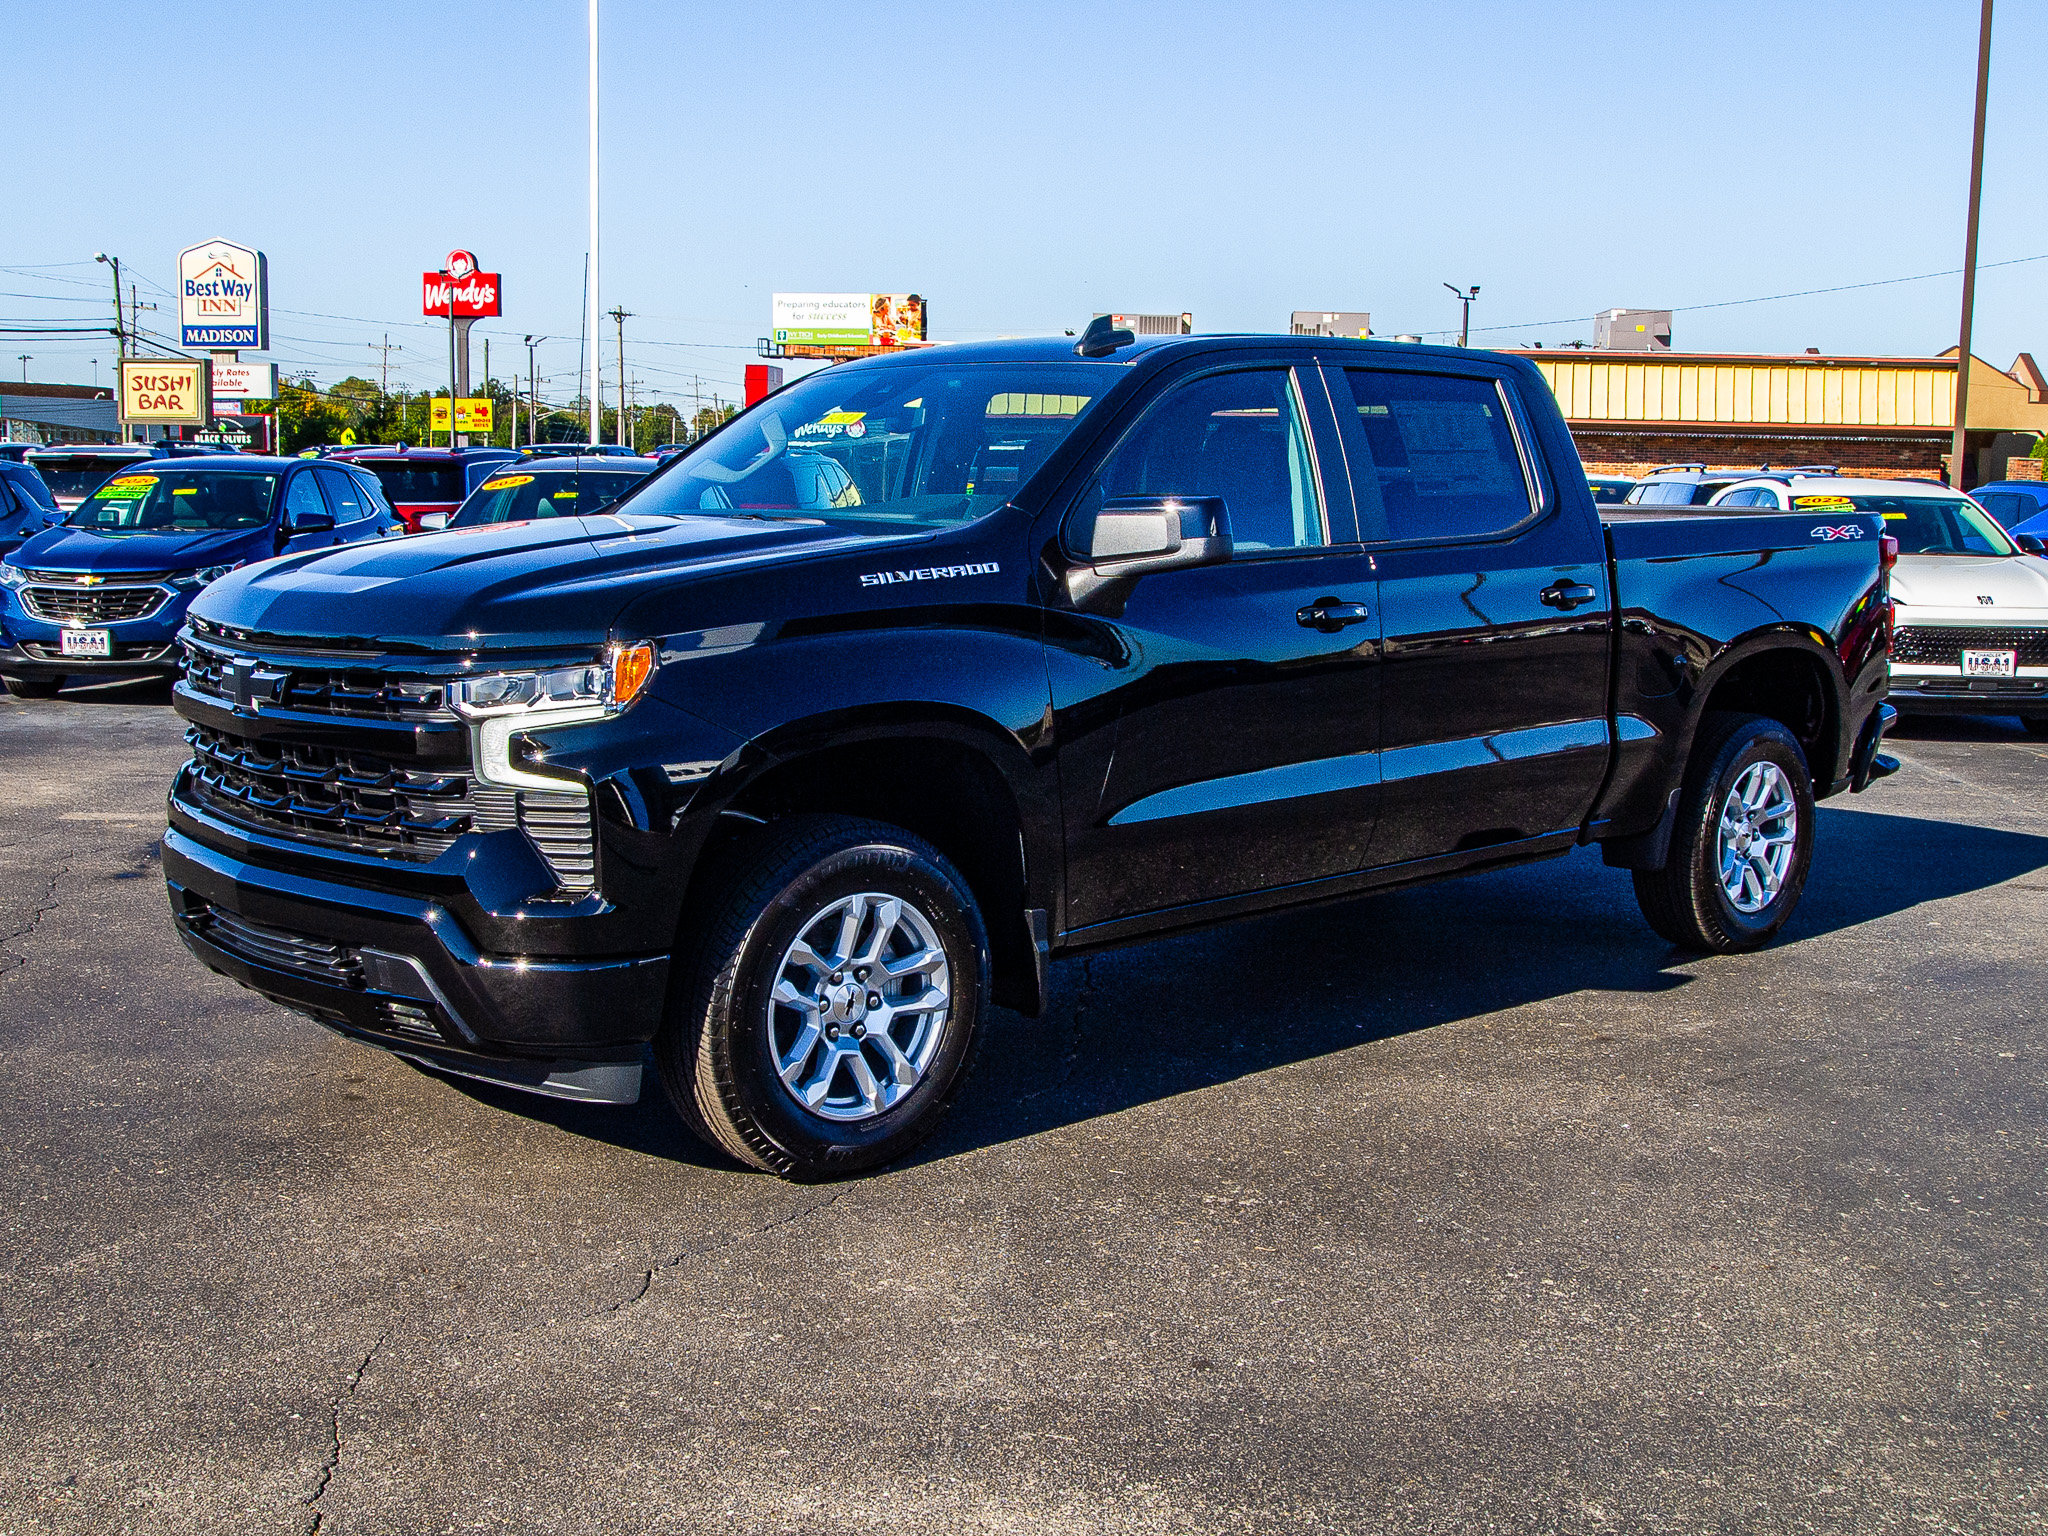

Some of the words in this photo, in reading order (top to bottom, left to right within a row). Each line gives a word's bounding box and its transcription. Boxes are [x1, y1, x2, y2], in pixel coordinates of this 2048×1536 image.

[185, 279, 219, 296] Best
[220, 279, 252, 302] Way
[425, 278, 495, 310] Wendy's
[201, 299, 236, 312] INN
[777, 300, 820, 311] Preparing
[822, 300, 866, 309] educators
[792, 312, 804, 320] for
[808, 313, 848, 321] success
[185, 329, 255, 343] MADISON
[131, 375, 191, 391] SUSHI
[212, 379, 243, 387] ailable
[138, 394, 184, 410] BAR
[194, 434, 220, 444] BLACK
[222, 434, 252, 444] OLIVES
[860, 561, 1000, 587] SILVERADO
